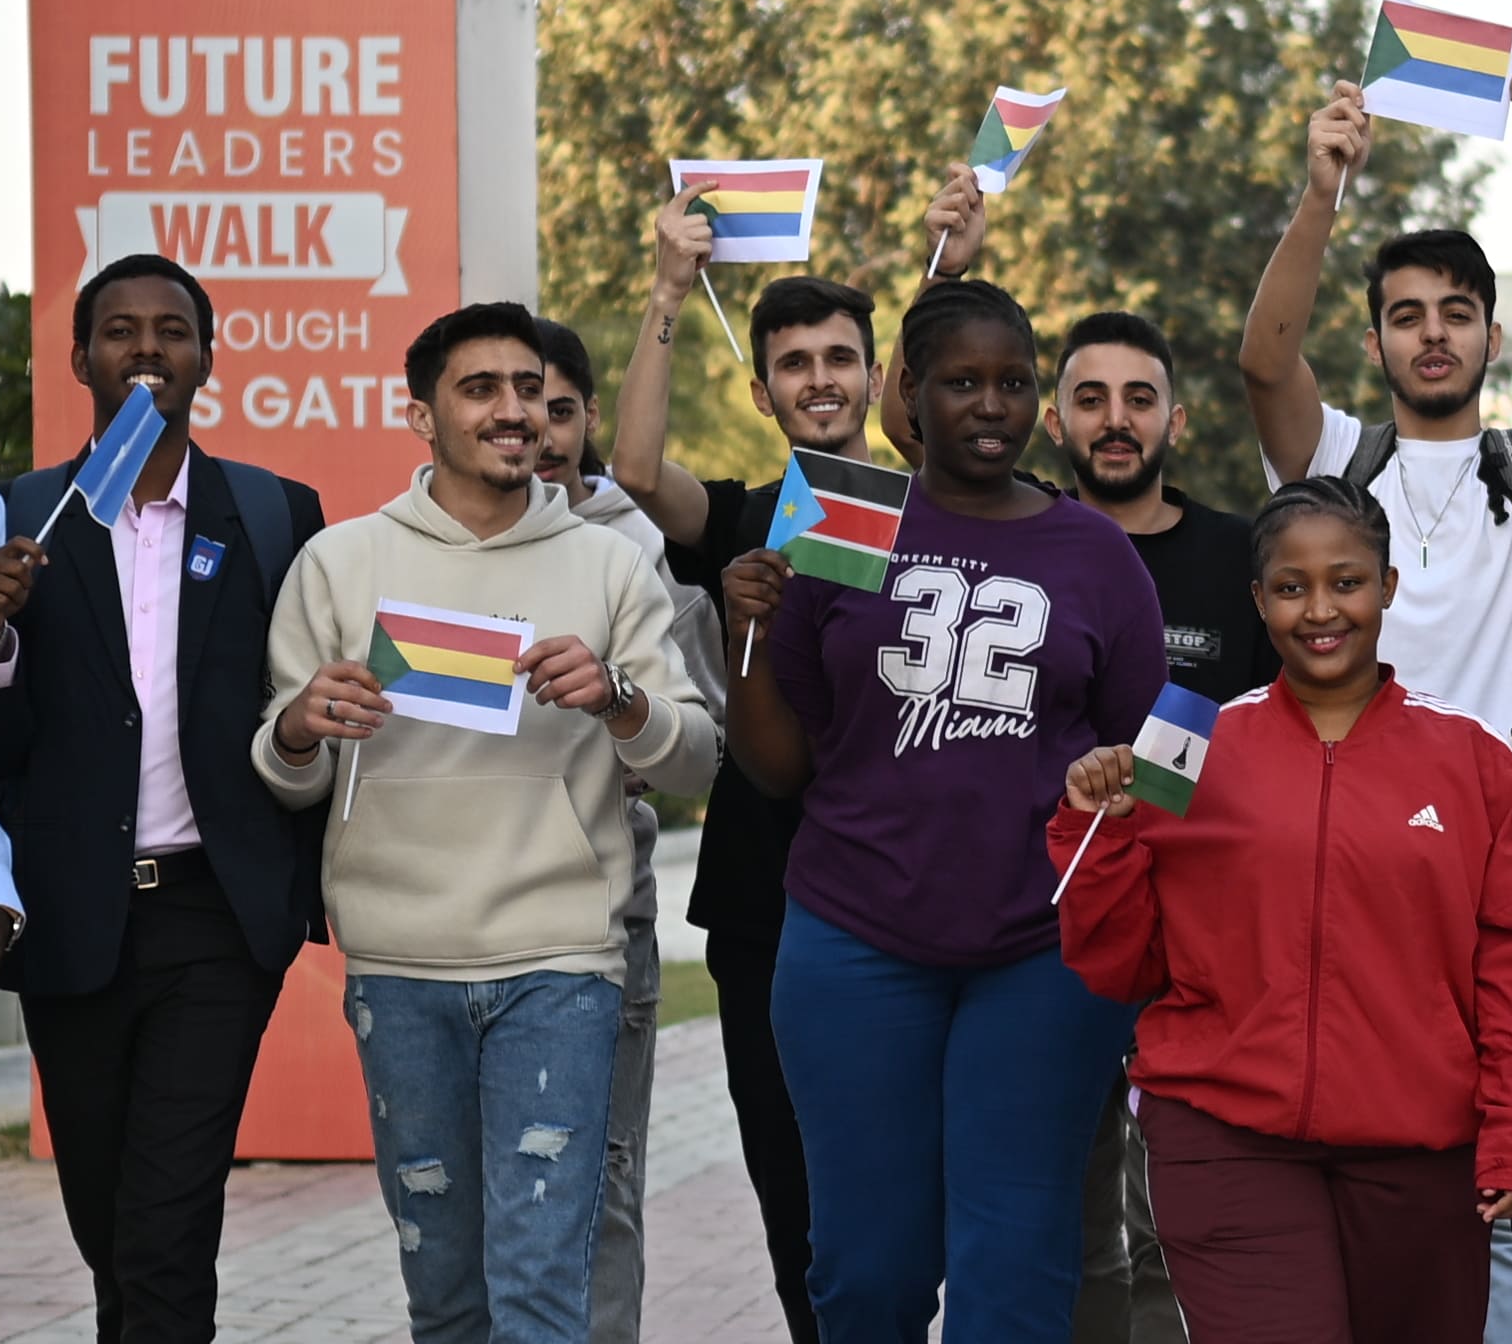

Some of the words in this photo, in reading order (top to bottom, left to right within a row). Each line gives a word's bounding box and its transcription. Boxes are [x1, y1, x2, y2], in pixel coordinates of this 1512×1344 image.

[88, 35, 403, 118] FUTURE
[88, 129, 405, 177] LEADERS
[150, 203, 333, 268] WALK
[212, 309, 369, 351] OUGH
[951, 557, 989, 572] CITY
[877, 564, 1051, 716] 32
[894, 695, 1036, 758] Miami
[1407, 817, 1444, 833] adidas
